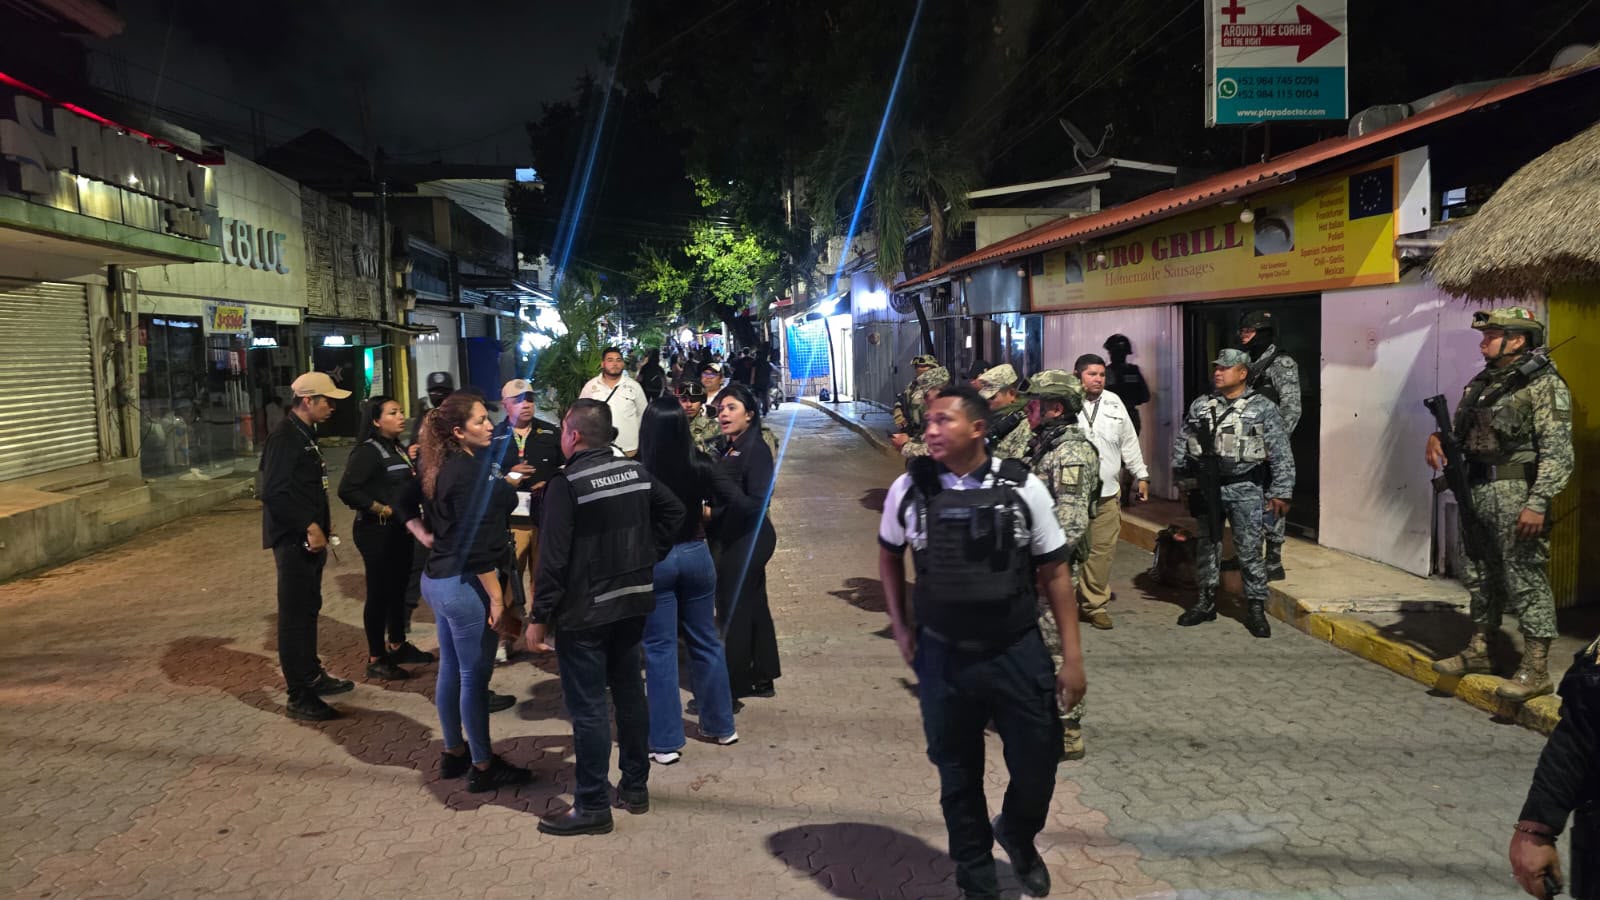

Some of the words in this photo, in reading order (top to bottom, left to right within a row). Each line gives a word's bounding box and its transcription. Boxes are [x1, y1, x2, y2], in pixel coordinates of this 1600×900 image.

[1223, 25, 1258, 37] AROUND
[1260, 25, 1276, 36] THE
[1278, 24, 1312, 36] CORNER
[1233, 38, 1243, 46] THE
[1237, 109, 1326, 117] www.playadoctor.com
[1086, 241, 1144, 272] EURO
[1151, 221, 1243, 261] GRILL
[1105, 265, 1160, 286] Homemade
[1163, 261, 1215, 278] Sausages
[590, 468, 639, 488] FISCALIZACIÓN
